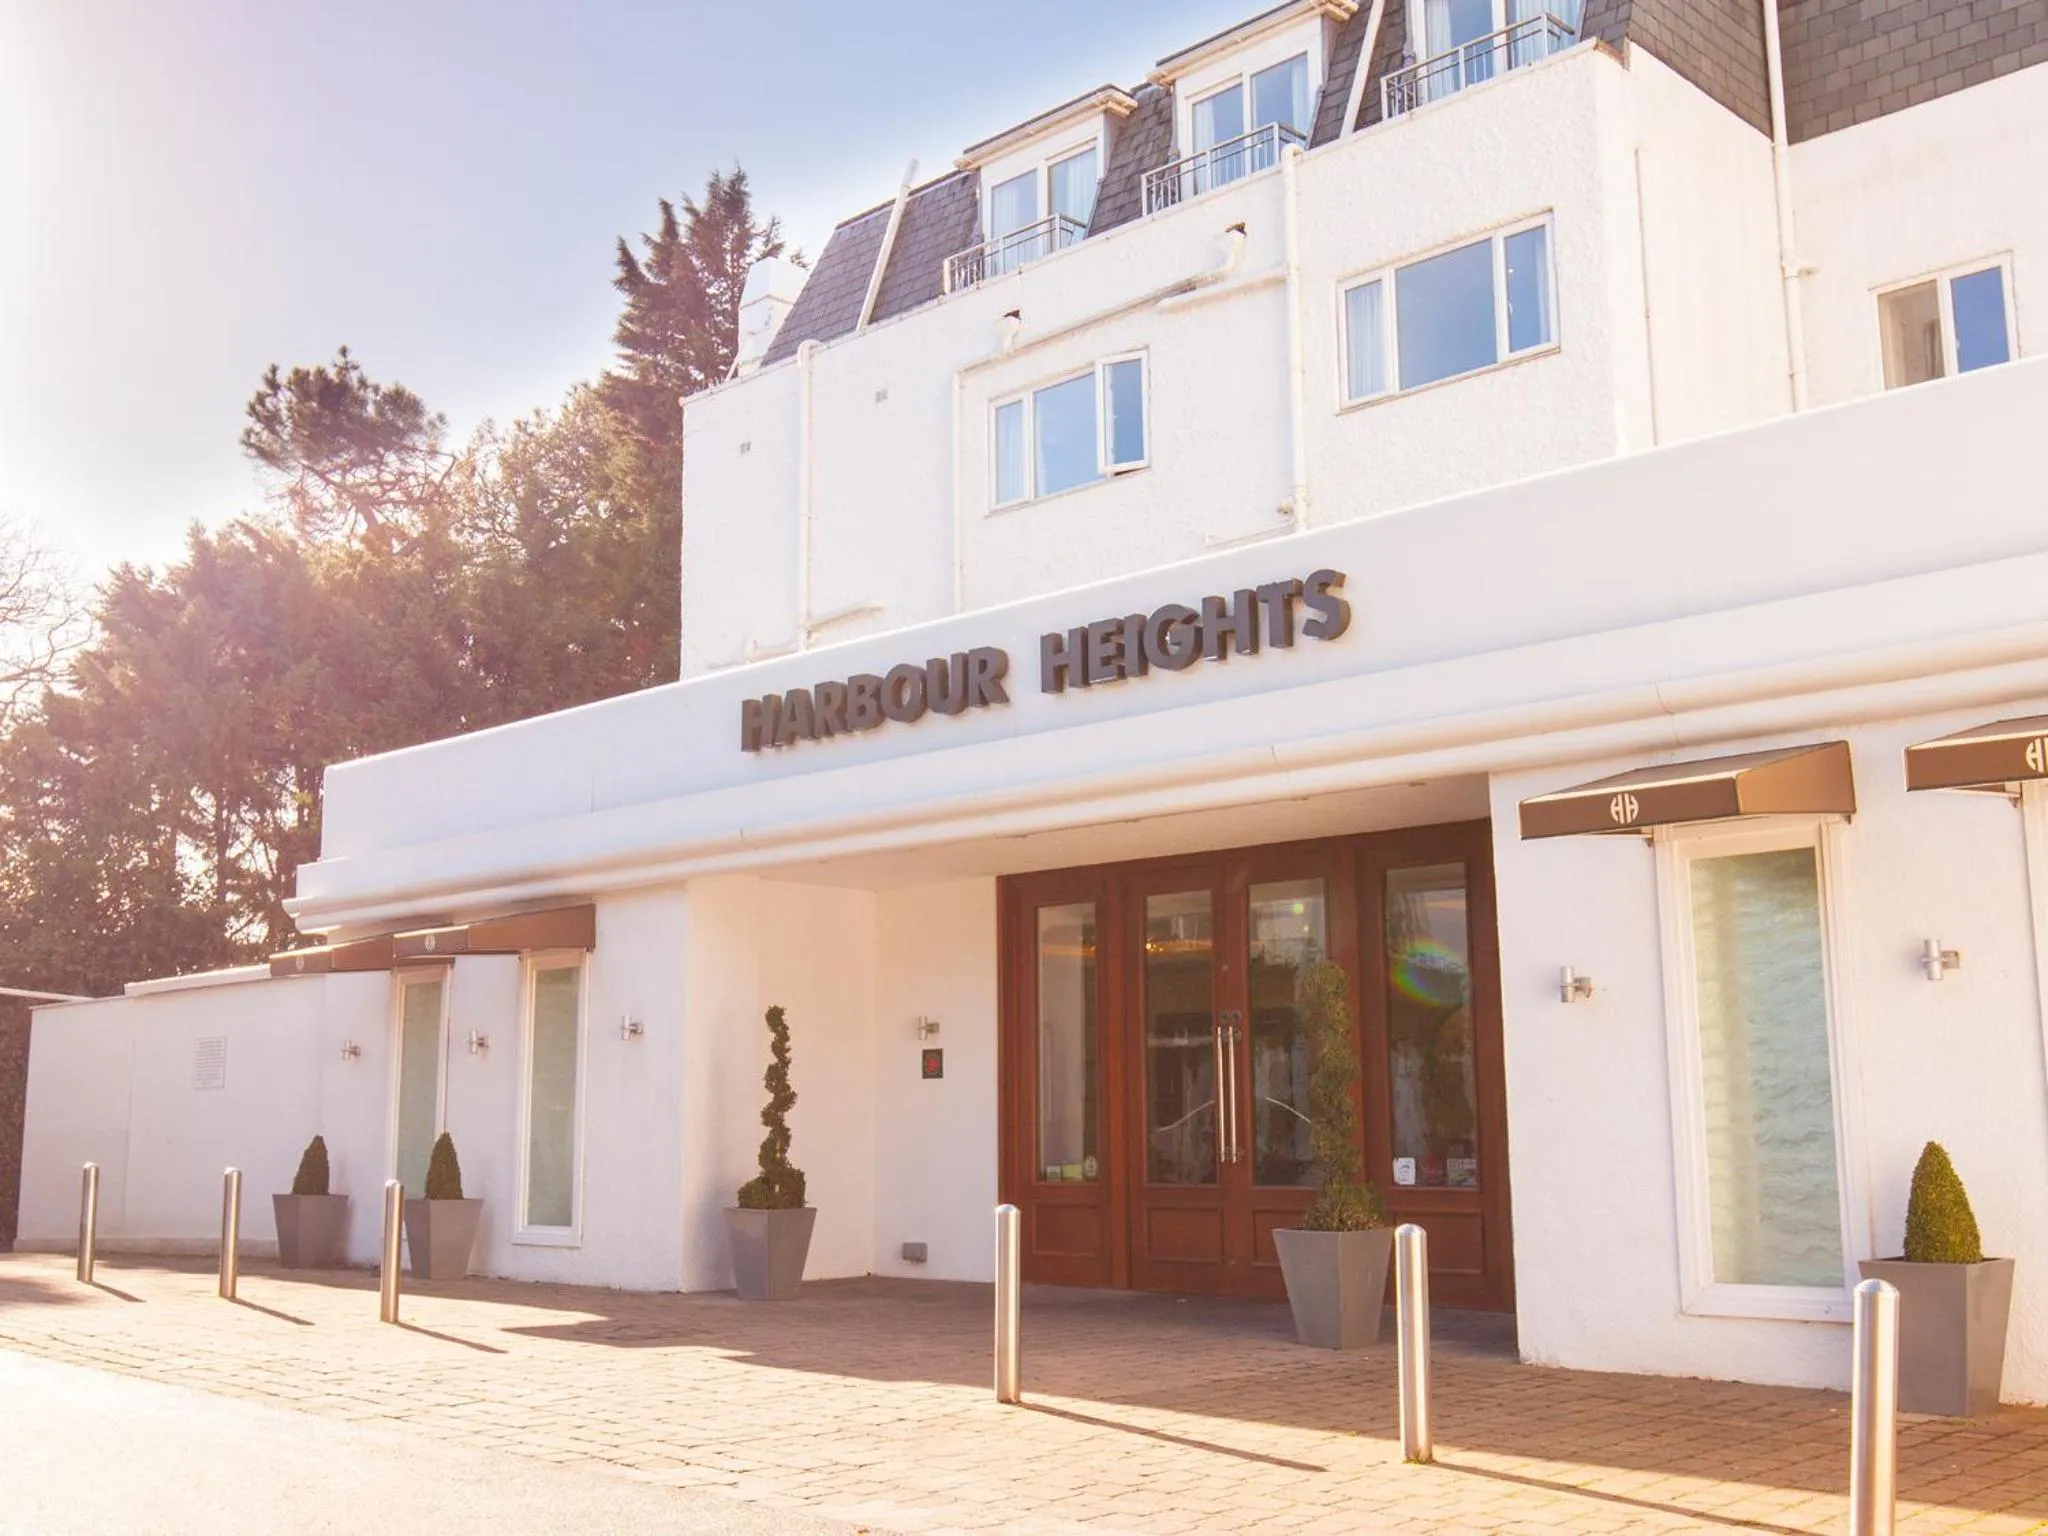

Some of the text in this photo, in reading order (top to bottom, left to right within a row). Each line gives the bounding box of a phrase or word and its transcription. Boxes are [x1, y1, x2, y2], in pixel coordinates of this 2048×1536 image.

[741, 568, 1351, 752] HARBOUR HEIGHTS
[2026, 738, 2048, 773] H
